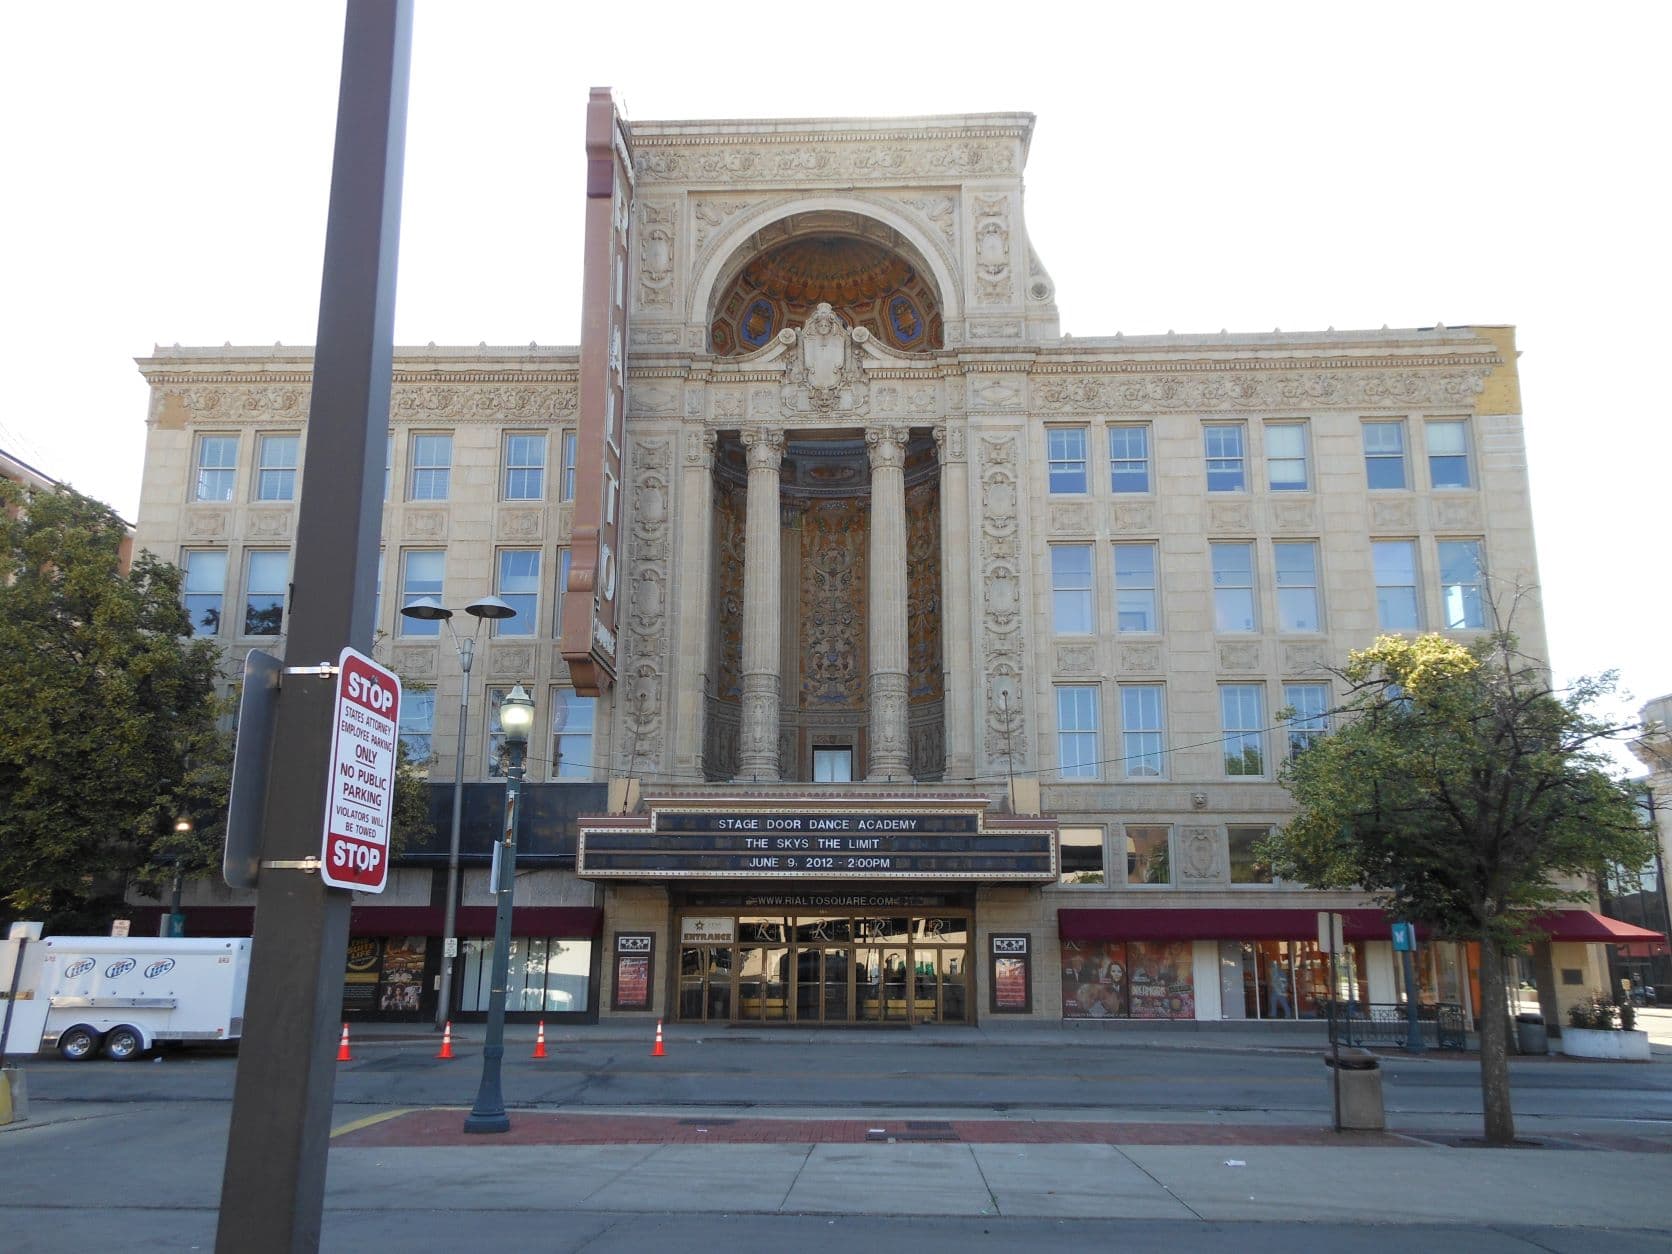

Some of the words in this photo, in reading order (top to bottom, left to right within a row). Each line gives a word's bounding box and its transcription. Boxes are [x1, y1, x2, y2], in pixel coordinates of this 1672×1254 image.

[348, 671, 393, 712] STOP
[345, 705, 364, 724] STATES
[365, 716, 392, 737] ATTORNEY
[341, 719, 370, 742] EMPLOYEE
[371, 734, 392, 753] PARKING
[355, 743, 378, 764] ONLY
[340, 762, 355, 779] NO
[358, 769, 387, 791] PUBLIC
[343, 782, 382, 807] PARKING
[336, 805, 369, 823] VIOLATORS
[371, 815, 385, 828] WILL
[718, 819, 758, 829] STAGE
[766, 819, 801, 829] DOOR
[809, 819, 850, 829] DANCE
[858, 819, 917, 829] ACADEMY
[345, 822, 353, 832] BE
[356, 824, 377, 838] TOWED
[333, 839, 380, 871] STOP
[745, 838, 769, 848] THE
[776, 838, 809, 849] SKYS
[817, 838, 841, 848] THE
[848, 838, 880, 848] LIMIT
[749, 858, 780, 868] JUNE
[806, 858, 833, 868] 2012
[848, 858, 890, 868] 2:00PM
